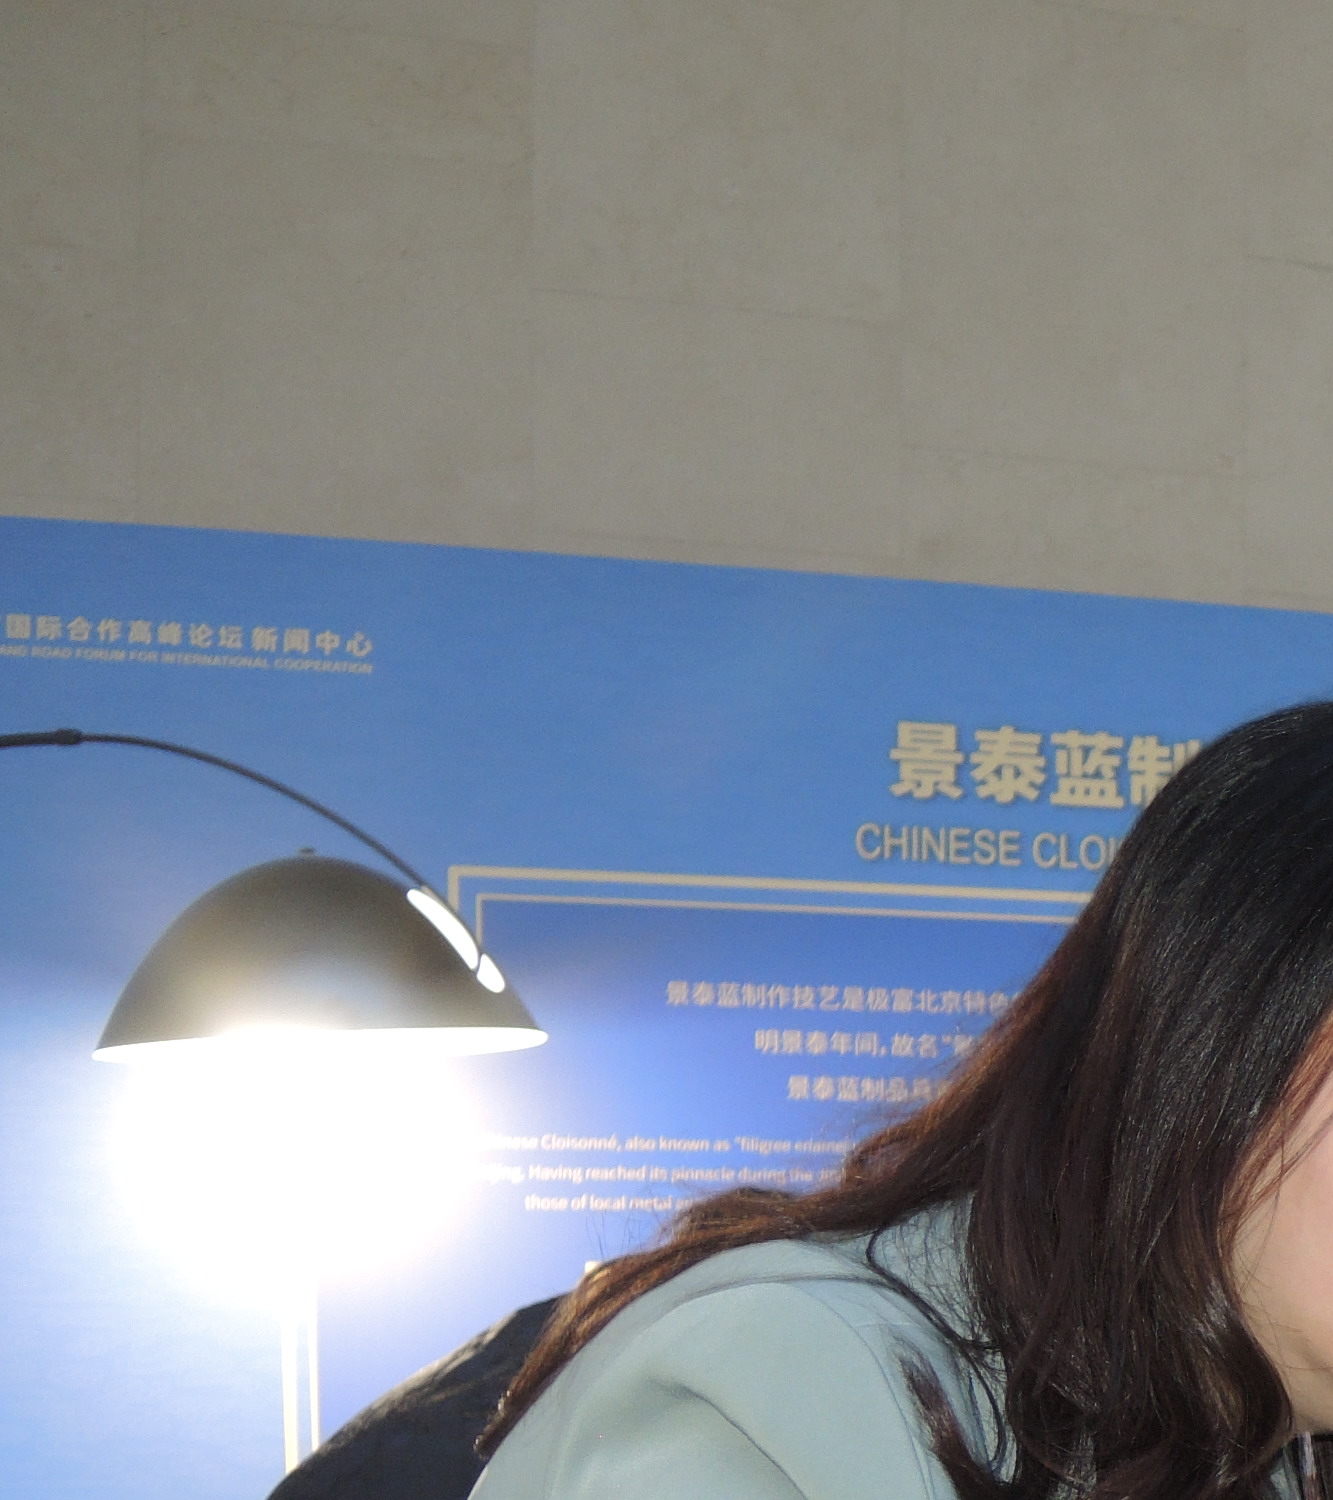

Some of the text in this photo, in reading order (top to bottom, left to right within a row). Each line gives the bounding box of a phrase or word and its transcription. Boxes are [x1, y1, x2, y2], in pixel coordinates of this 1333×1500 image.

[855, 822, 1124, 872] CHINESE CLOI
[625, 1135, 657, 1151] also
[659, 1136, 710, 1151] known
[713, 1139, 730, 1152] as
[528, 1164, 583, 1184] Having
[585, 1164, 647, 1181] reached
[650, 1166, 667, 1181] its
[671, 1166, 735, 1184] pinnacle
[738, 1166, 787, 1186] during
[525, 1193, 568, 1211] those
[571, 1193, 589, 1211] of
[590, 1194, 627, 1211] local
[629, 1194, 673, 1211] metal
